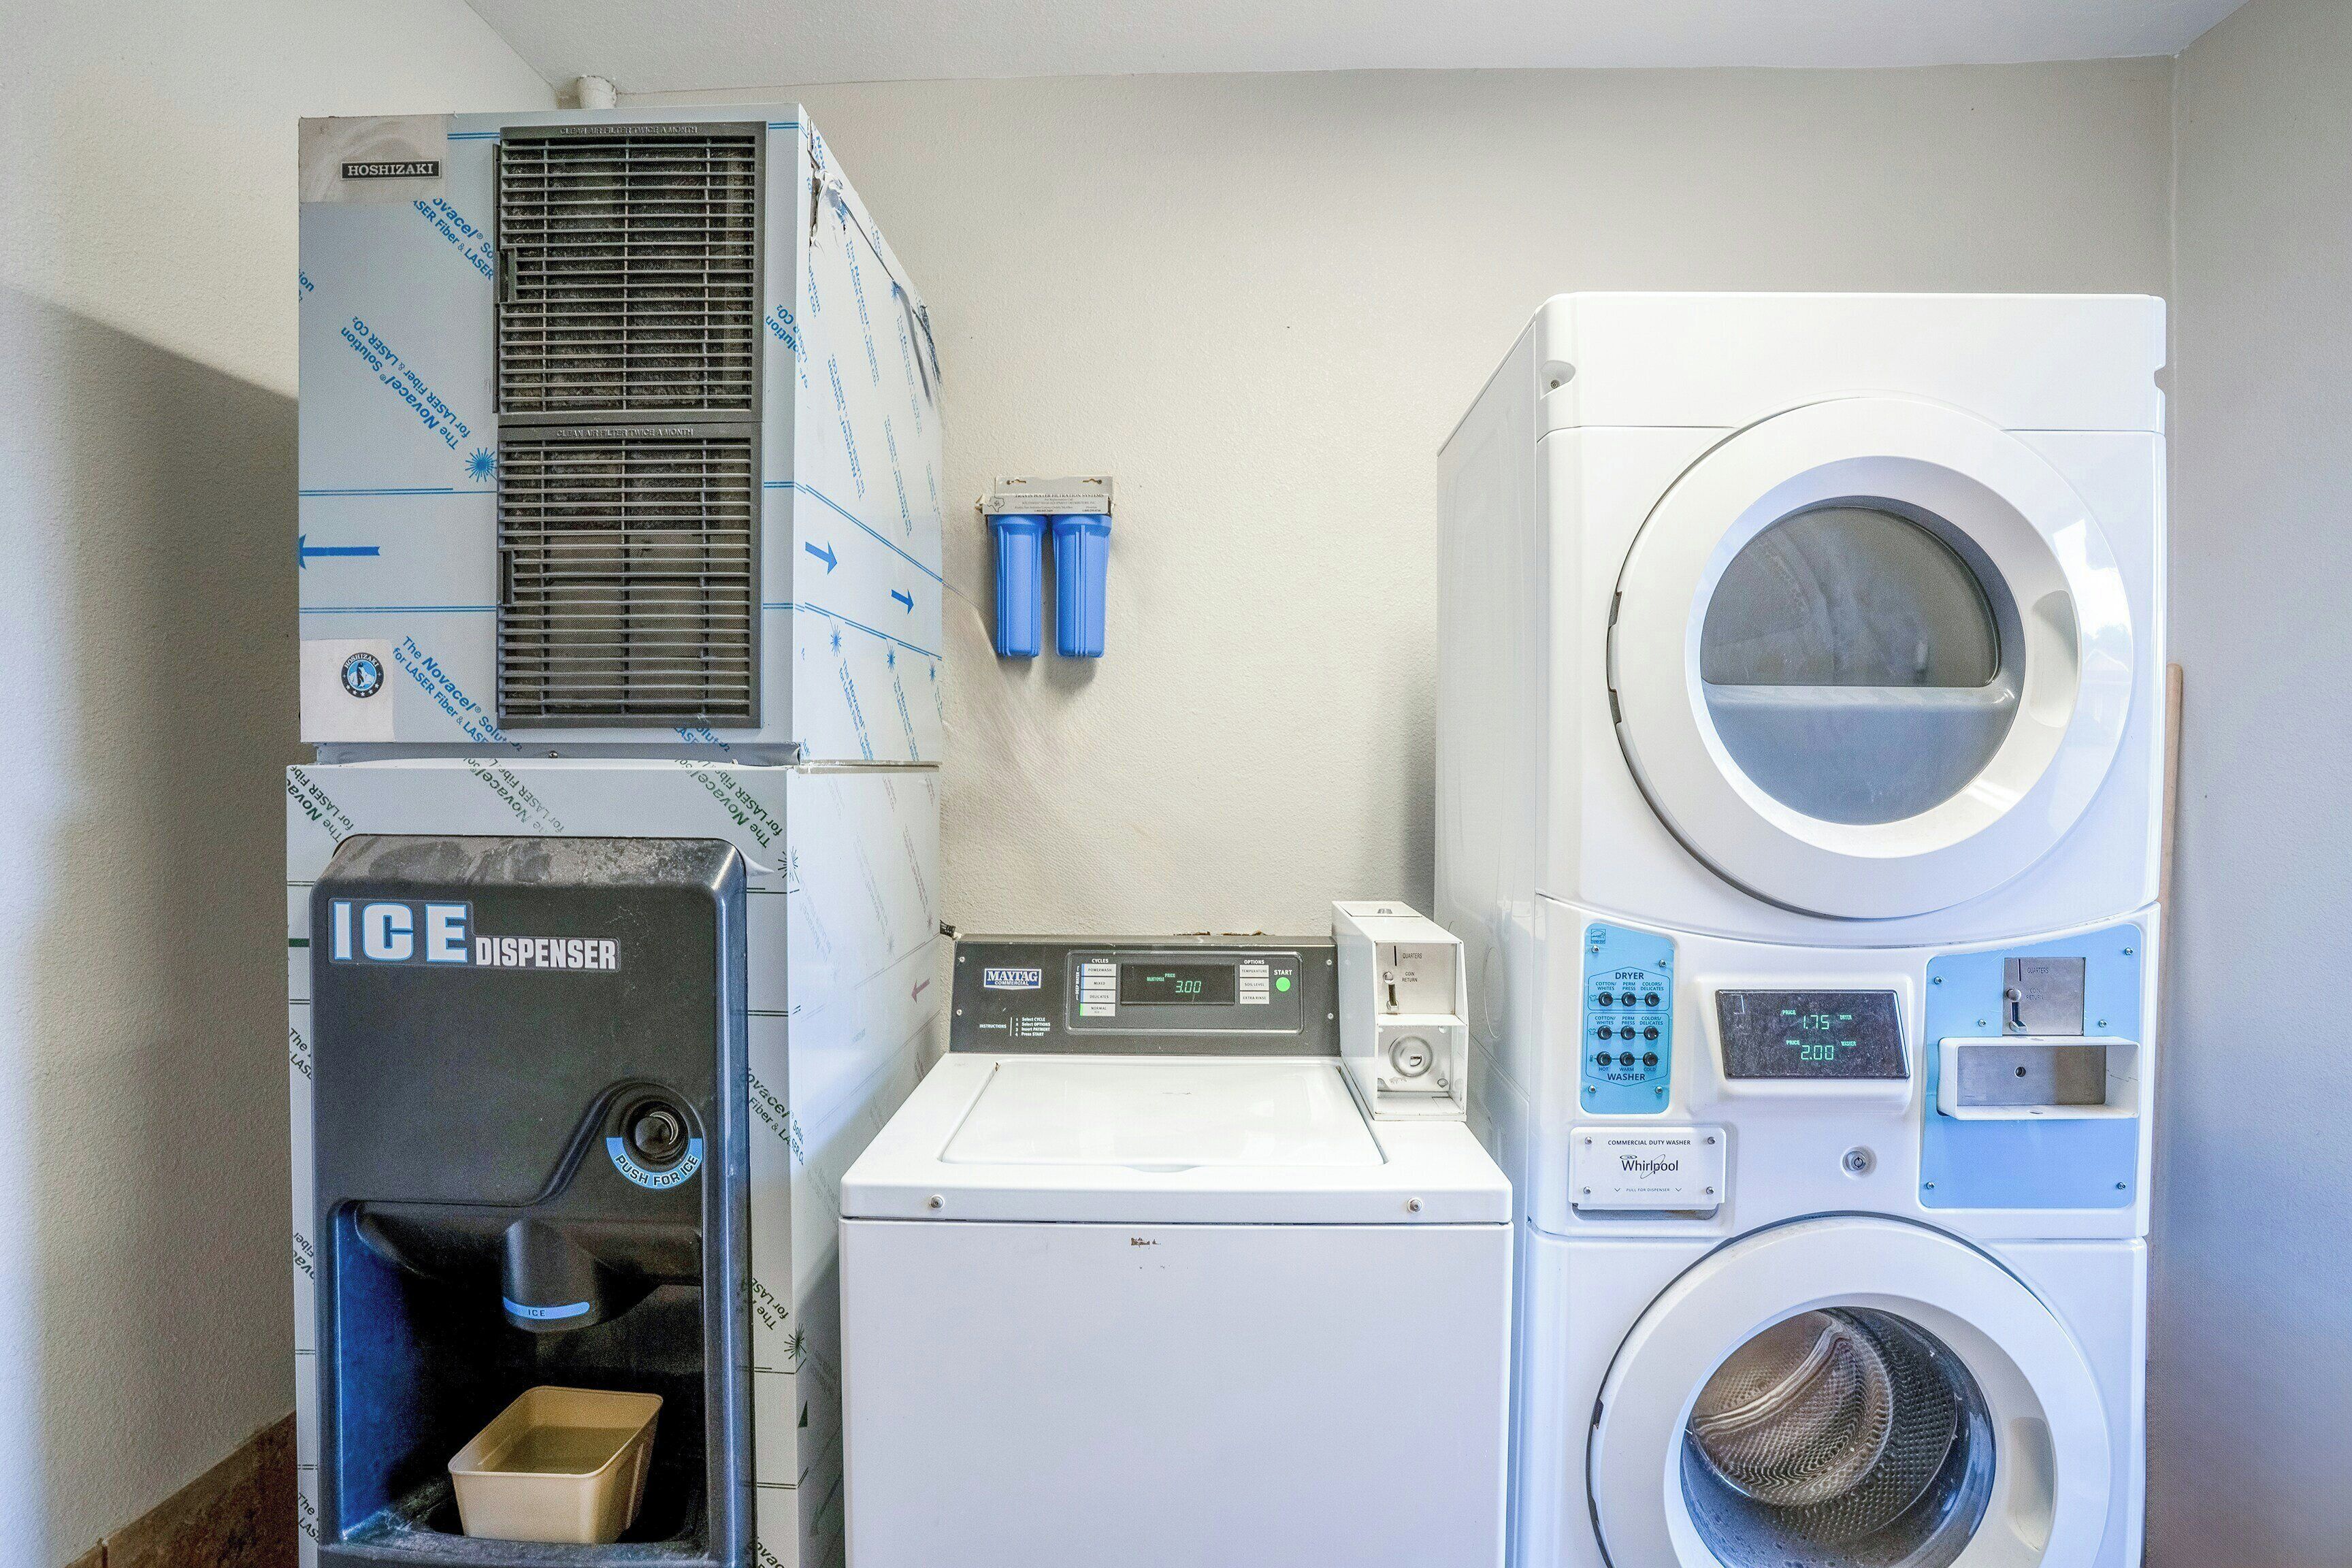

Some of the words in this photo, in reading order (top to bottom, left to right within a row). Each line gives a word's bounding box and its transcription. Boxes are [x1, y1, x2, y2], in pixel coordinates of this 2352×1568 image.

[668, 125, 698, 133] MONTH
[347, 163, 434, 176] HOSHIZAKI
[435, 218, 459, 244] Fiber
[457, 242, 466, 252] &
[464, 248, 493, 280] LASER
[341, 327, 382, 372] Solution
[368, 333, 399, 365] LASER
[397, 361, 406, 371] &
[403, 370, 428, 395] Fiber
[426, 391, 457, 425] LASER
[440, 426, 459, 450] The
[454, 421, 471, 439] for
[402, 636, 421, 659] The
[344, 654, 380, 668] HOSHIZAKI
[393, 647, 407, 664] for
[405, 662, 435, 694] LASER
[434, 691, 459, 717] Fiber
[455, 715, 463, 725] &
[308, 783, 340, 817] LASER
[518, 785, 550, 819] LASER
[735, 786, 768, 821] LASER
[323, 819, 342, 843] The
[338, 815, 354, 831] for
[766, 819, 783, 836] for
[749, 823, 770, 849] The
[333, 902, 468, 963] ICE
[476, 936, 617, 970] DISPENSER
[987, 970, 1039, 981] MAYTAG
[1175, 980, 1202, 993] 3.00
[1615, 972, 1644, 980] DRYER
[1803, 1014, 1830, 1030] 1.75
[289, 1027, 308, 1051] The
[1801, 1045, 1834, 1060] 2.00
[1607, 1073, 1646, 1081] WASHER
[749, 1096, 774, 1124] Fiber
[615, 1154, 650, 1185] PUSH
[653, 1171, 682, 1186] FOR
[679, 1154, 699, 1176] ICE
[1621, 1160, 1679, 1175] Whirlpool
[528, 1309, 546, 1317] ICE
[757, 1306, 777, 1330] The
[772, 1303, 789, 1320] for
